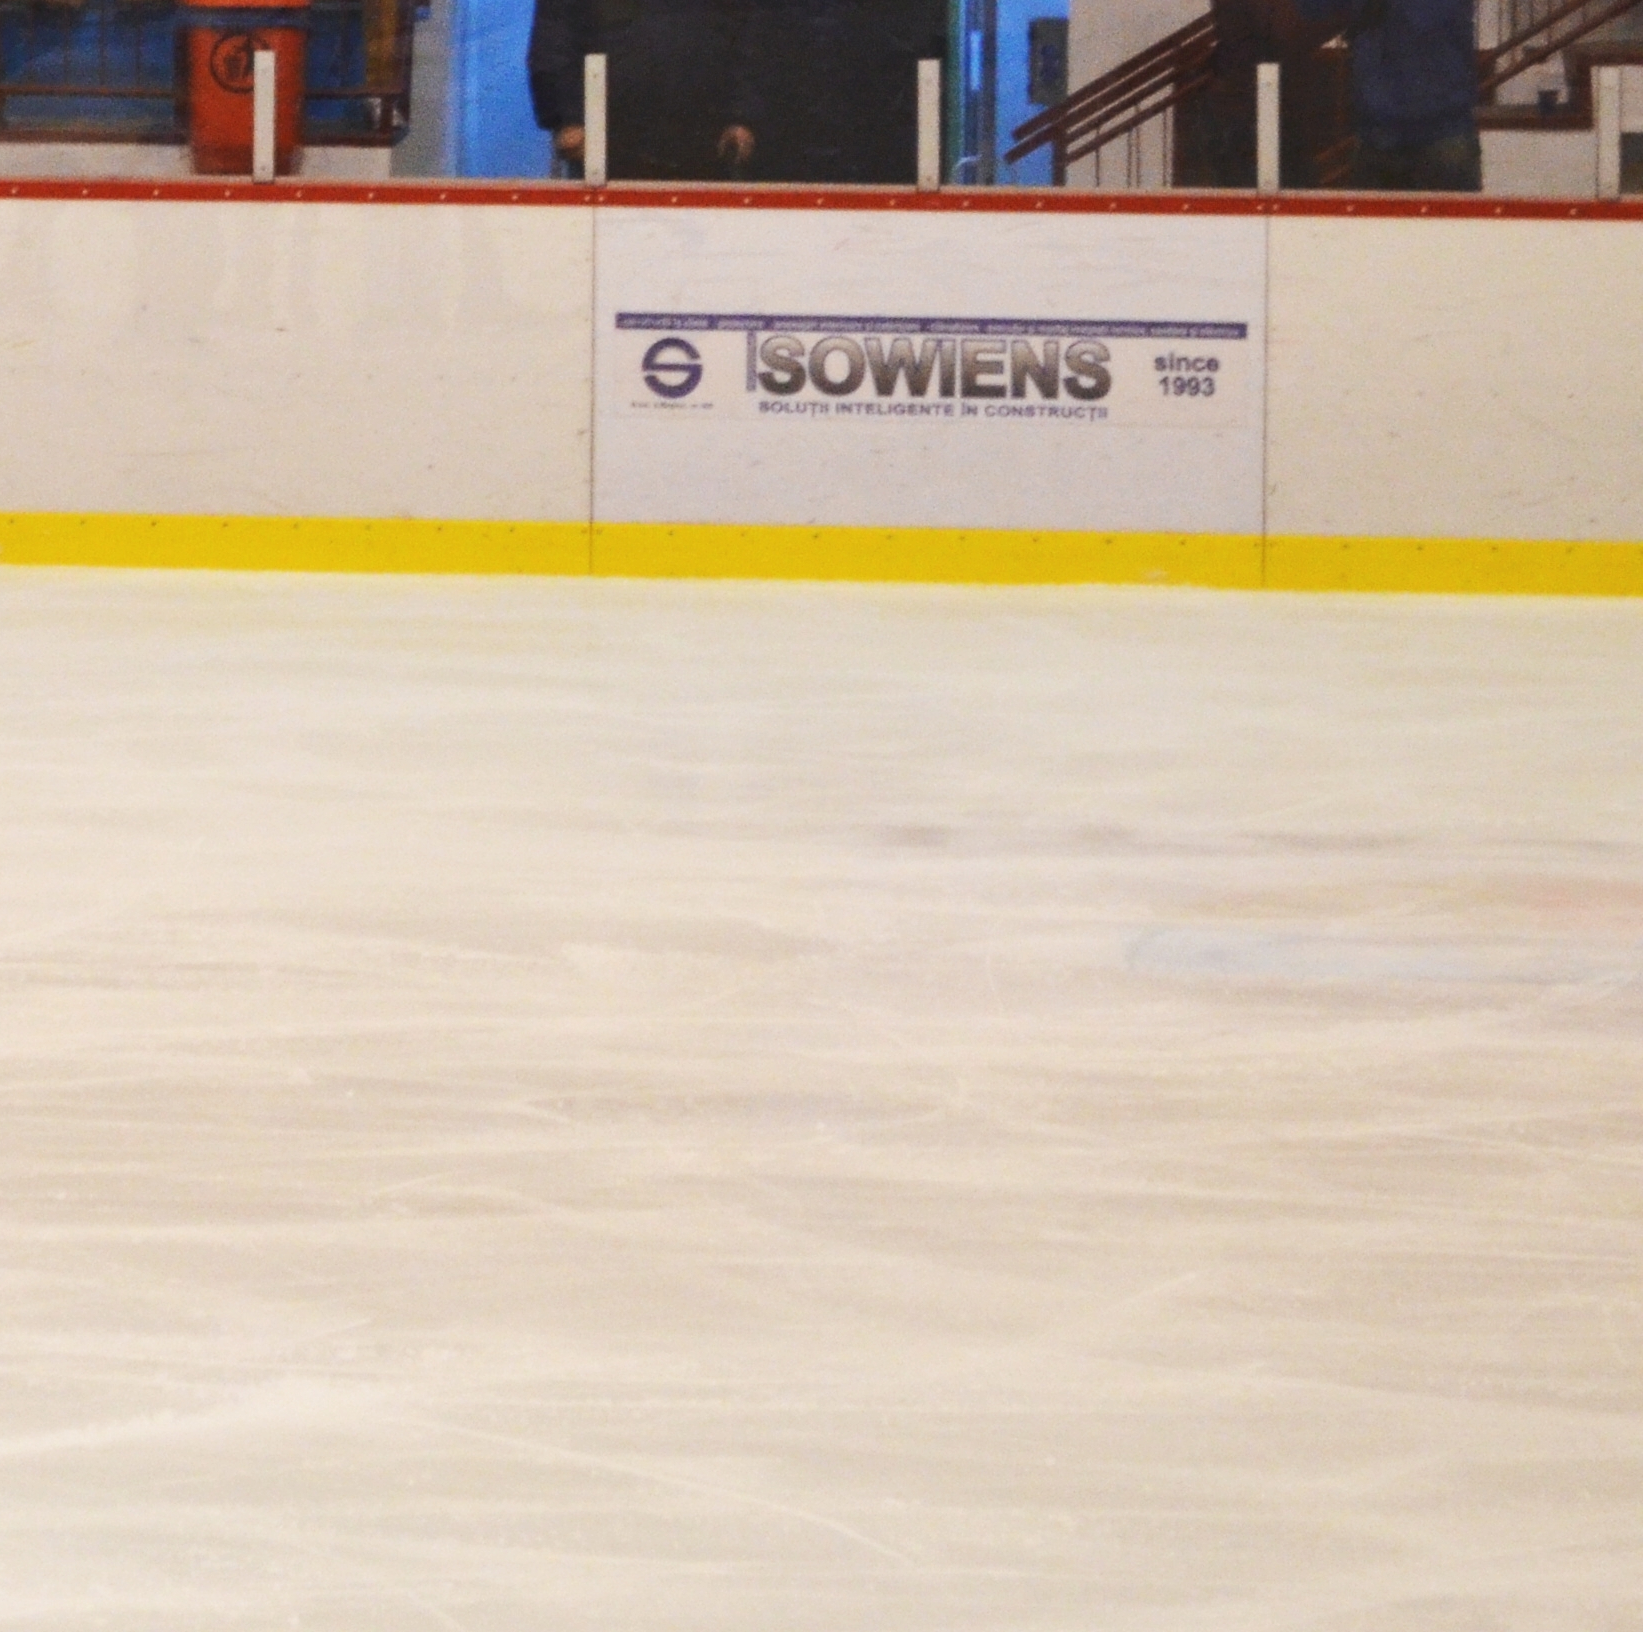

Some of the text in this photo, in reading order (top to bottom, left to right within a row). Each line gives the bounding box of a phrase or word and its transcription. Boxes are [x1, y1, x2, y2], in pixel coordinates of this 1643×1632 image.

[757, 334, 1112, 400] SOWIENS
[1155, 352, 1219, 373] since
[1158, 376, 1216, 397] 1993
[835, 401, 955, 417] INTELIGENTE
